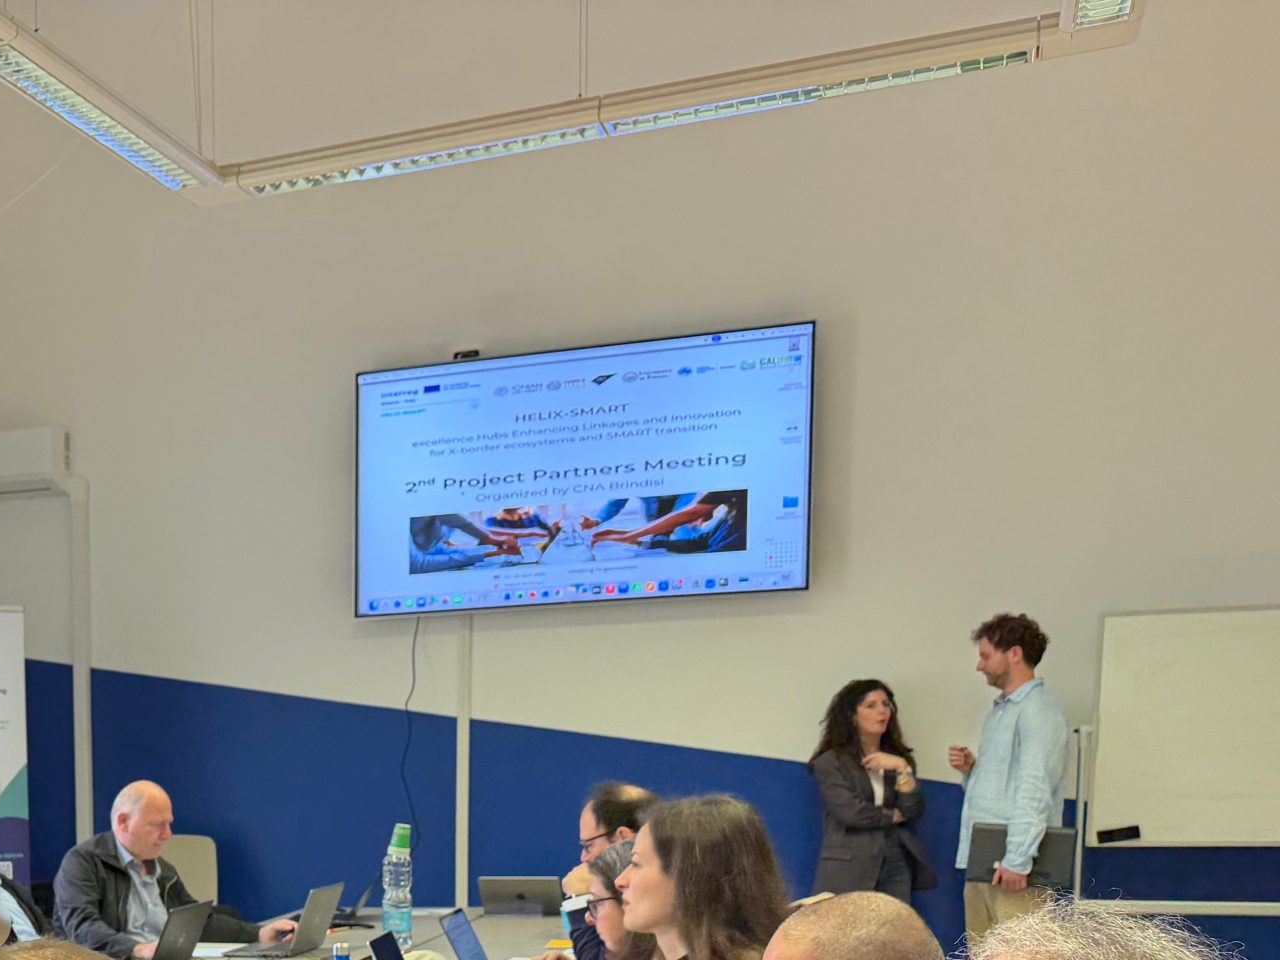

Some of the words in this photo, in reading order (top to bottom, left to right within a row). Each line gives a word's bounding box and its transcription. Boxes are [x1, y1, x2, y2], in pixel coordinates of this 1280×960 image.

[411, 434, 475, 448] excellence
[477, 430, 509, 441] Hubs
[512, 424, 579, 439] Enhancing
[583, 416, 640, 431] Linkages
[643, 412, 668, 425] and
[671, 407, 742, 423] Innovation
[514, 403, 630, 424] HELIX-SMART
[429, 449, 445, 458] for
[448, 443, 501, 456] X-border
[504, 438, 575, 451] ecosystems
[579, 431, 603, 442] and
[606, 427, 652, 441] SMART
[655, 422, 718, 436] transition
[405, 477, 436, 494] 2nd
[443, 472, 525, 490] Project
[533, 461, 636, 481] Partners
[644, 452, 748, 472] Meeting
[475, 487, 548, 502] Organized
[552, 484, 569, 496] by
[572, 481, 606, 494] CNA
[609, 478, 665, 491] Brindisi
